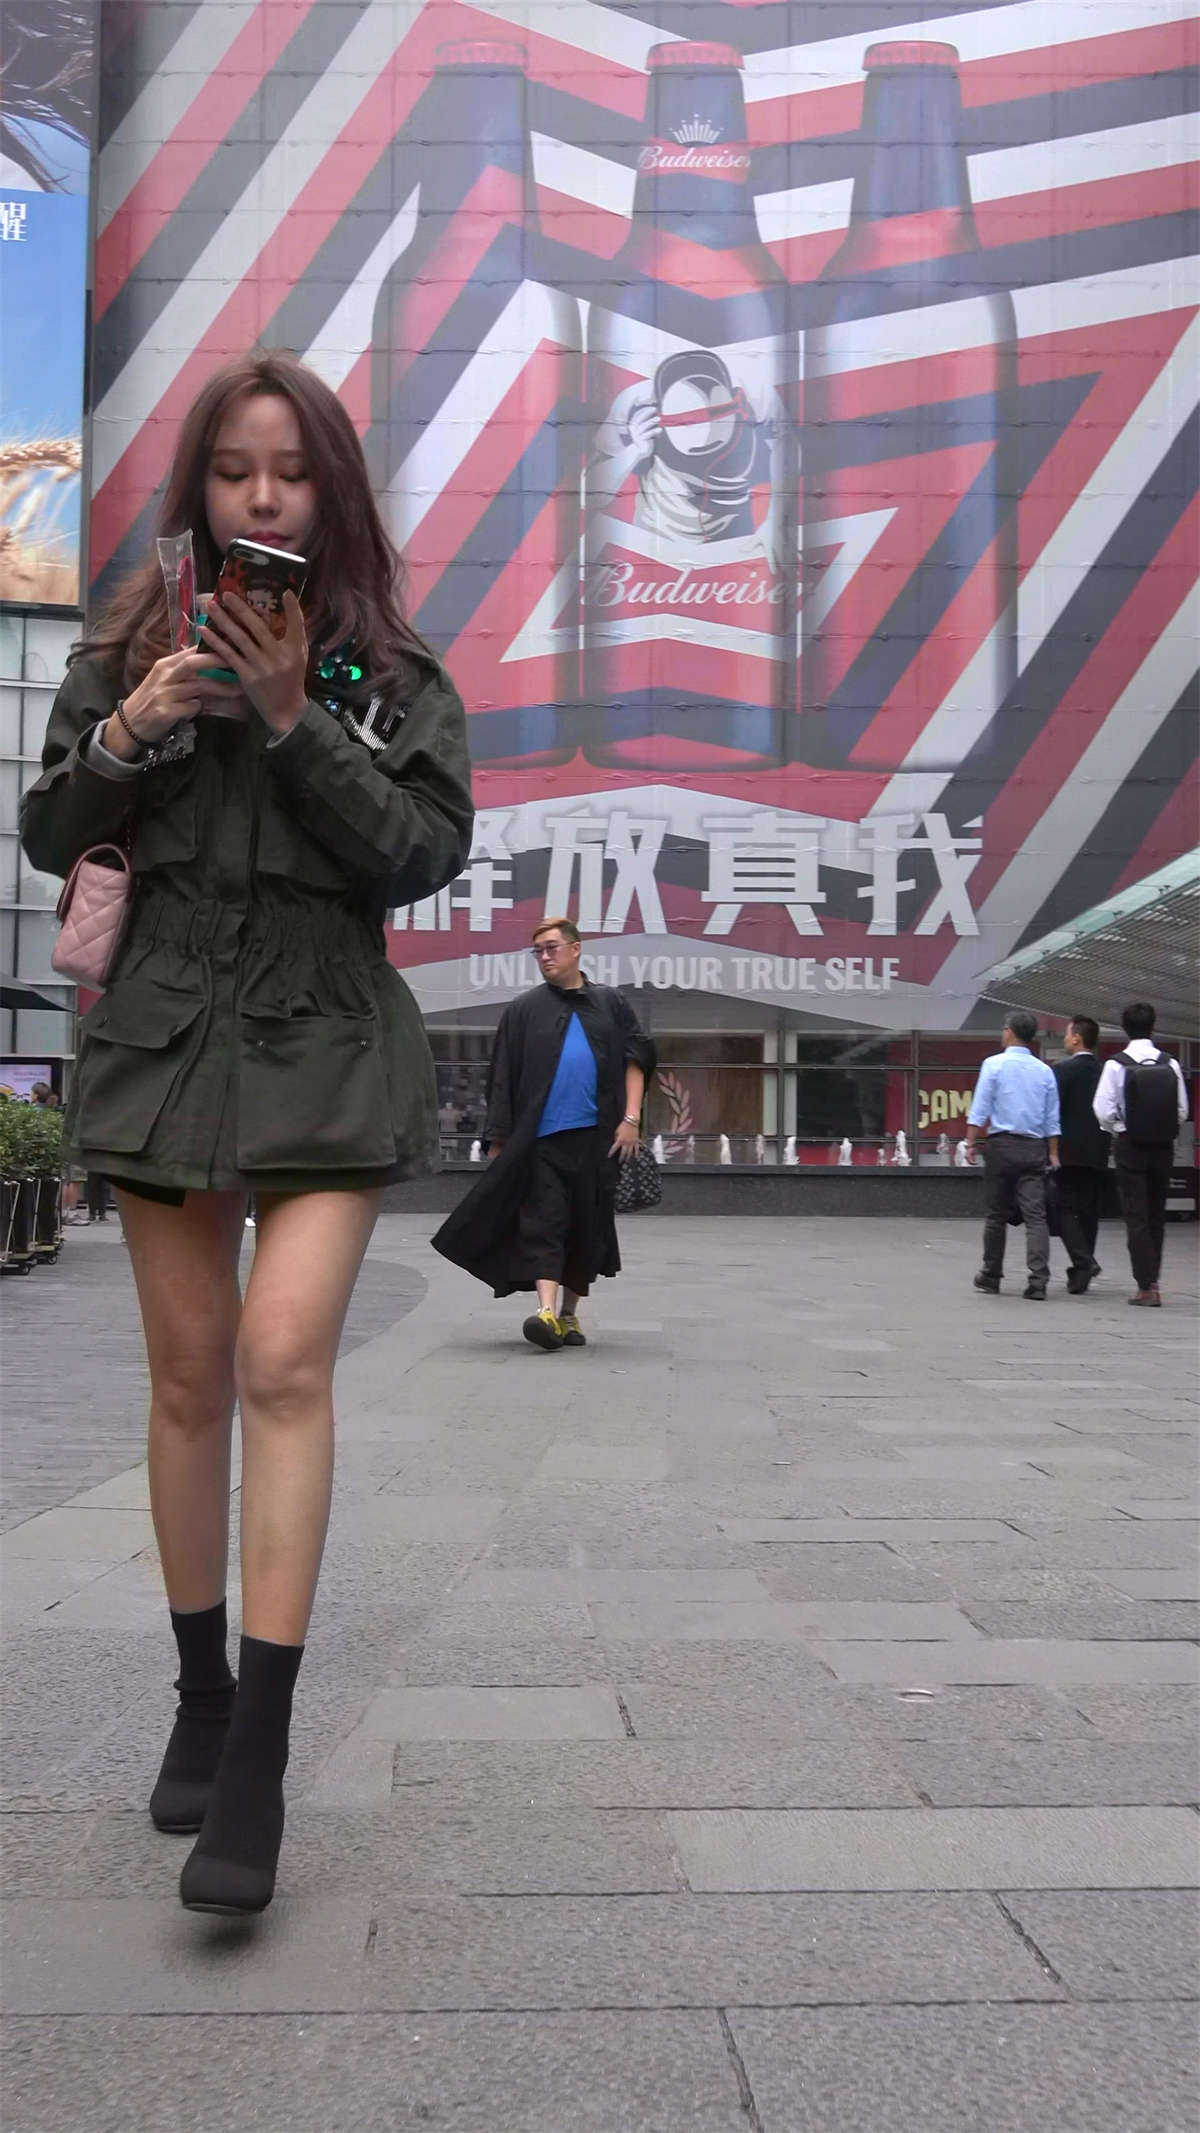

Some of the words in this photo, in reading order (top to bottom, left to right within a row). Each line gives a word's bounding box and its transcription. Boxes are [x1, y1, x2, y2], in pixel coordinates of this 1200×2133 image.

[596, 560, 806, 607] Budweise
[470, 953, 620, 988] UNLSH
[628, 956, 723, 990] YOUR
[731, 957, 817, 991] TRUE
[825, 957, 900, 991] SELF
